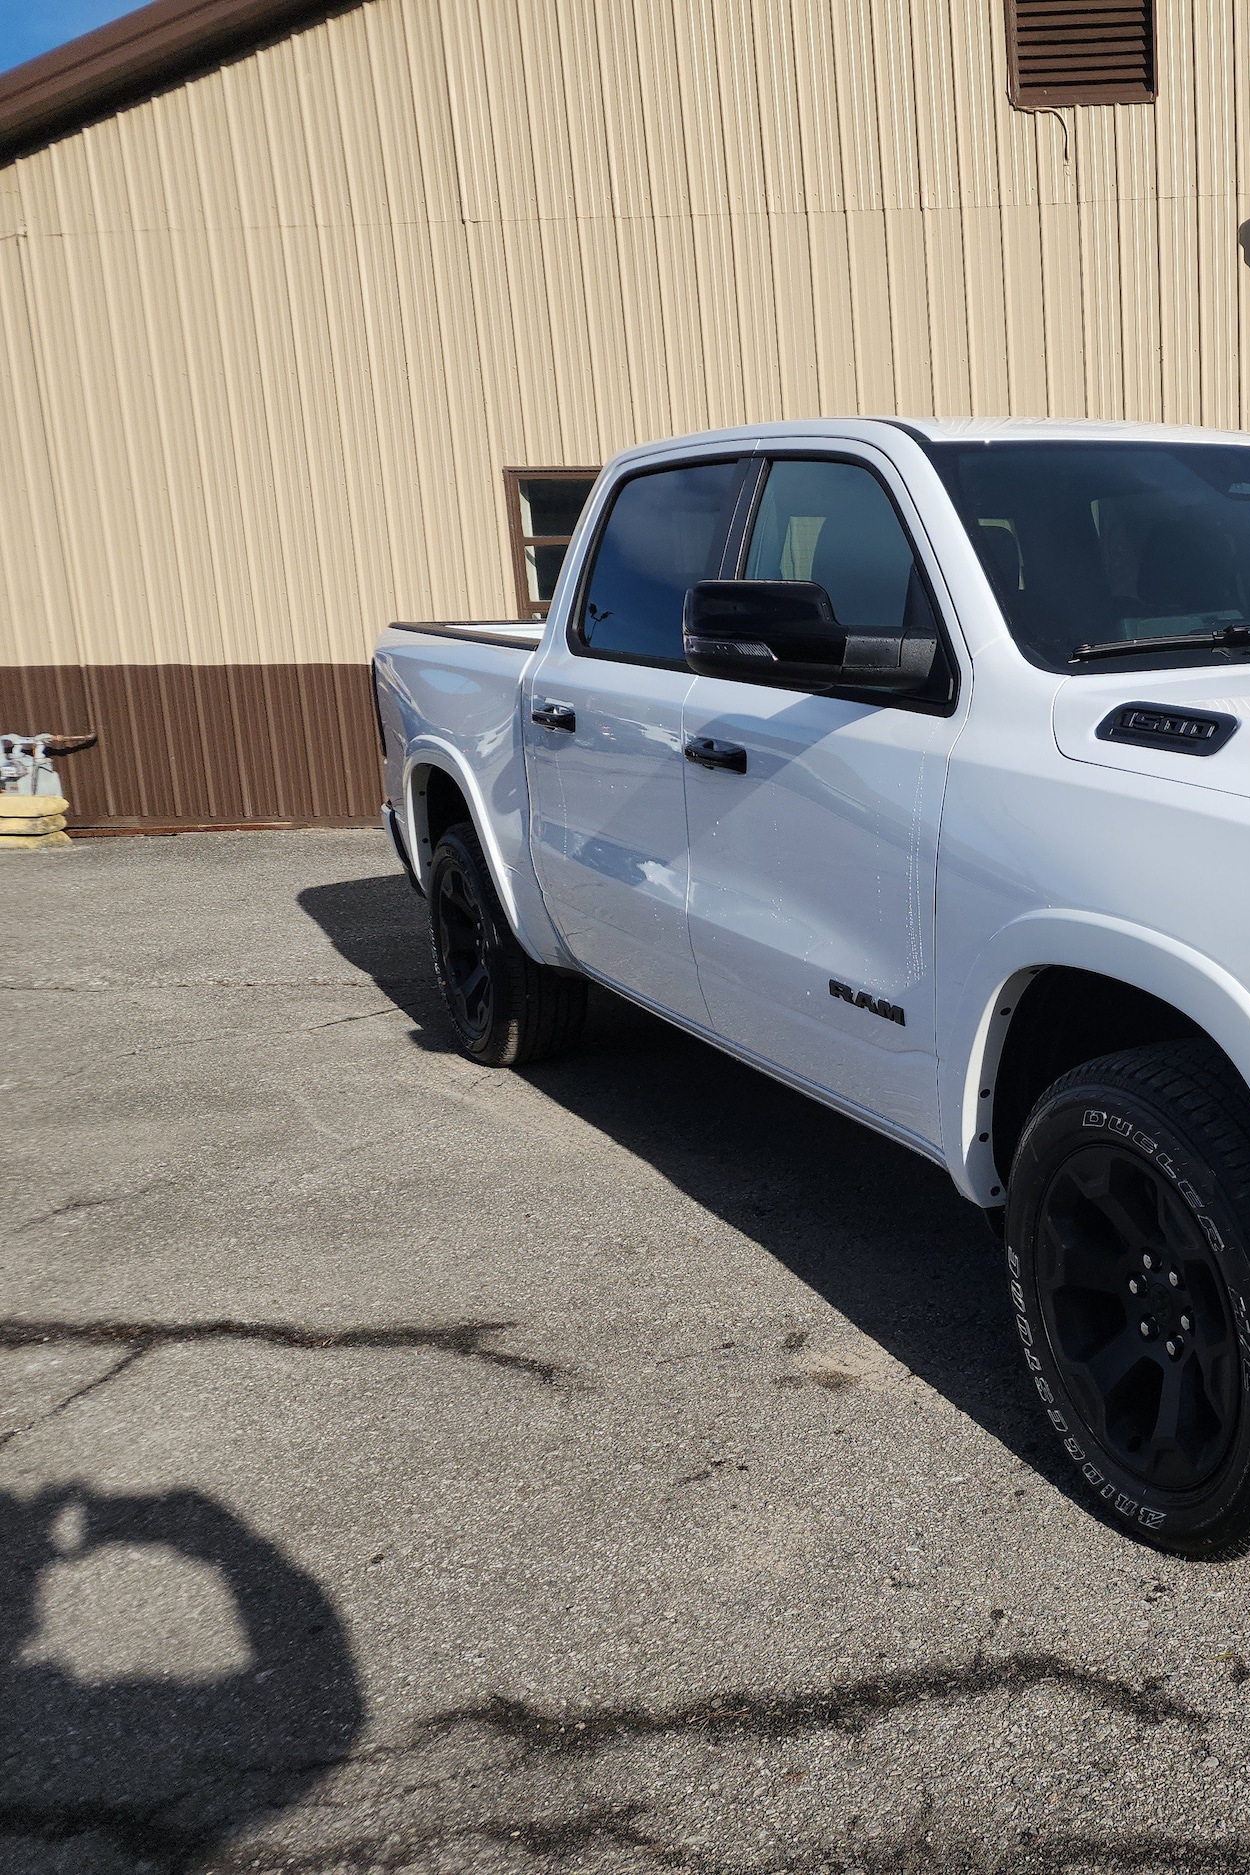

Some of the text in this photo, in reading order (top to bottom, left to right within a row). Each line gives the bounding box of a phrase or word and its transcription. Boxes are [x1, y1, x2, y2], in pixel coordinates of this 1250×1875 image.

[1120, 711, 1217, 740] 1500
[828, 979, 906, 1027] RAM
[1081, 1108, 1226, 1253] DUELER
[1005, 1244, 1168, 1531] BRIDGESTONE
